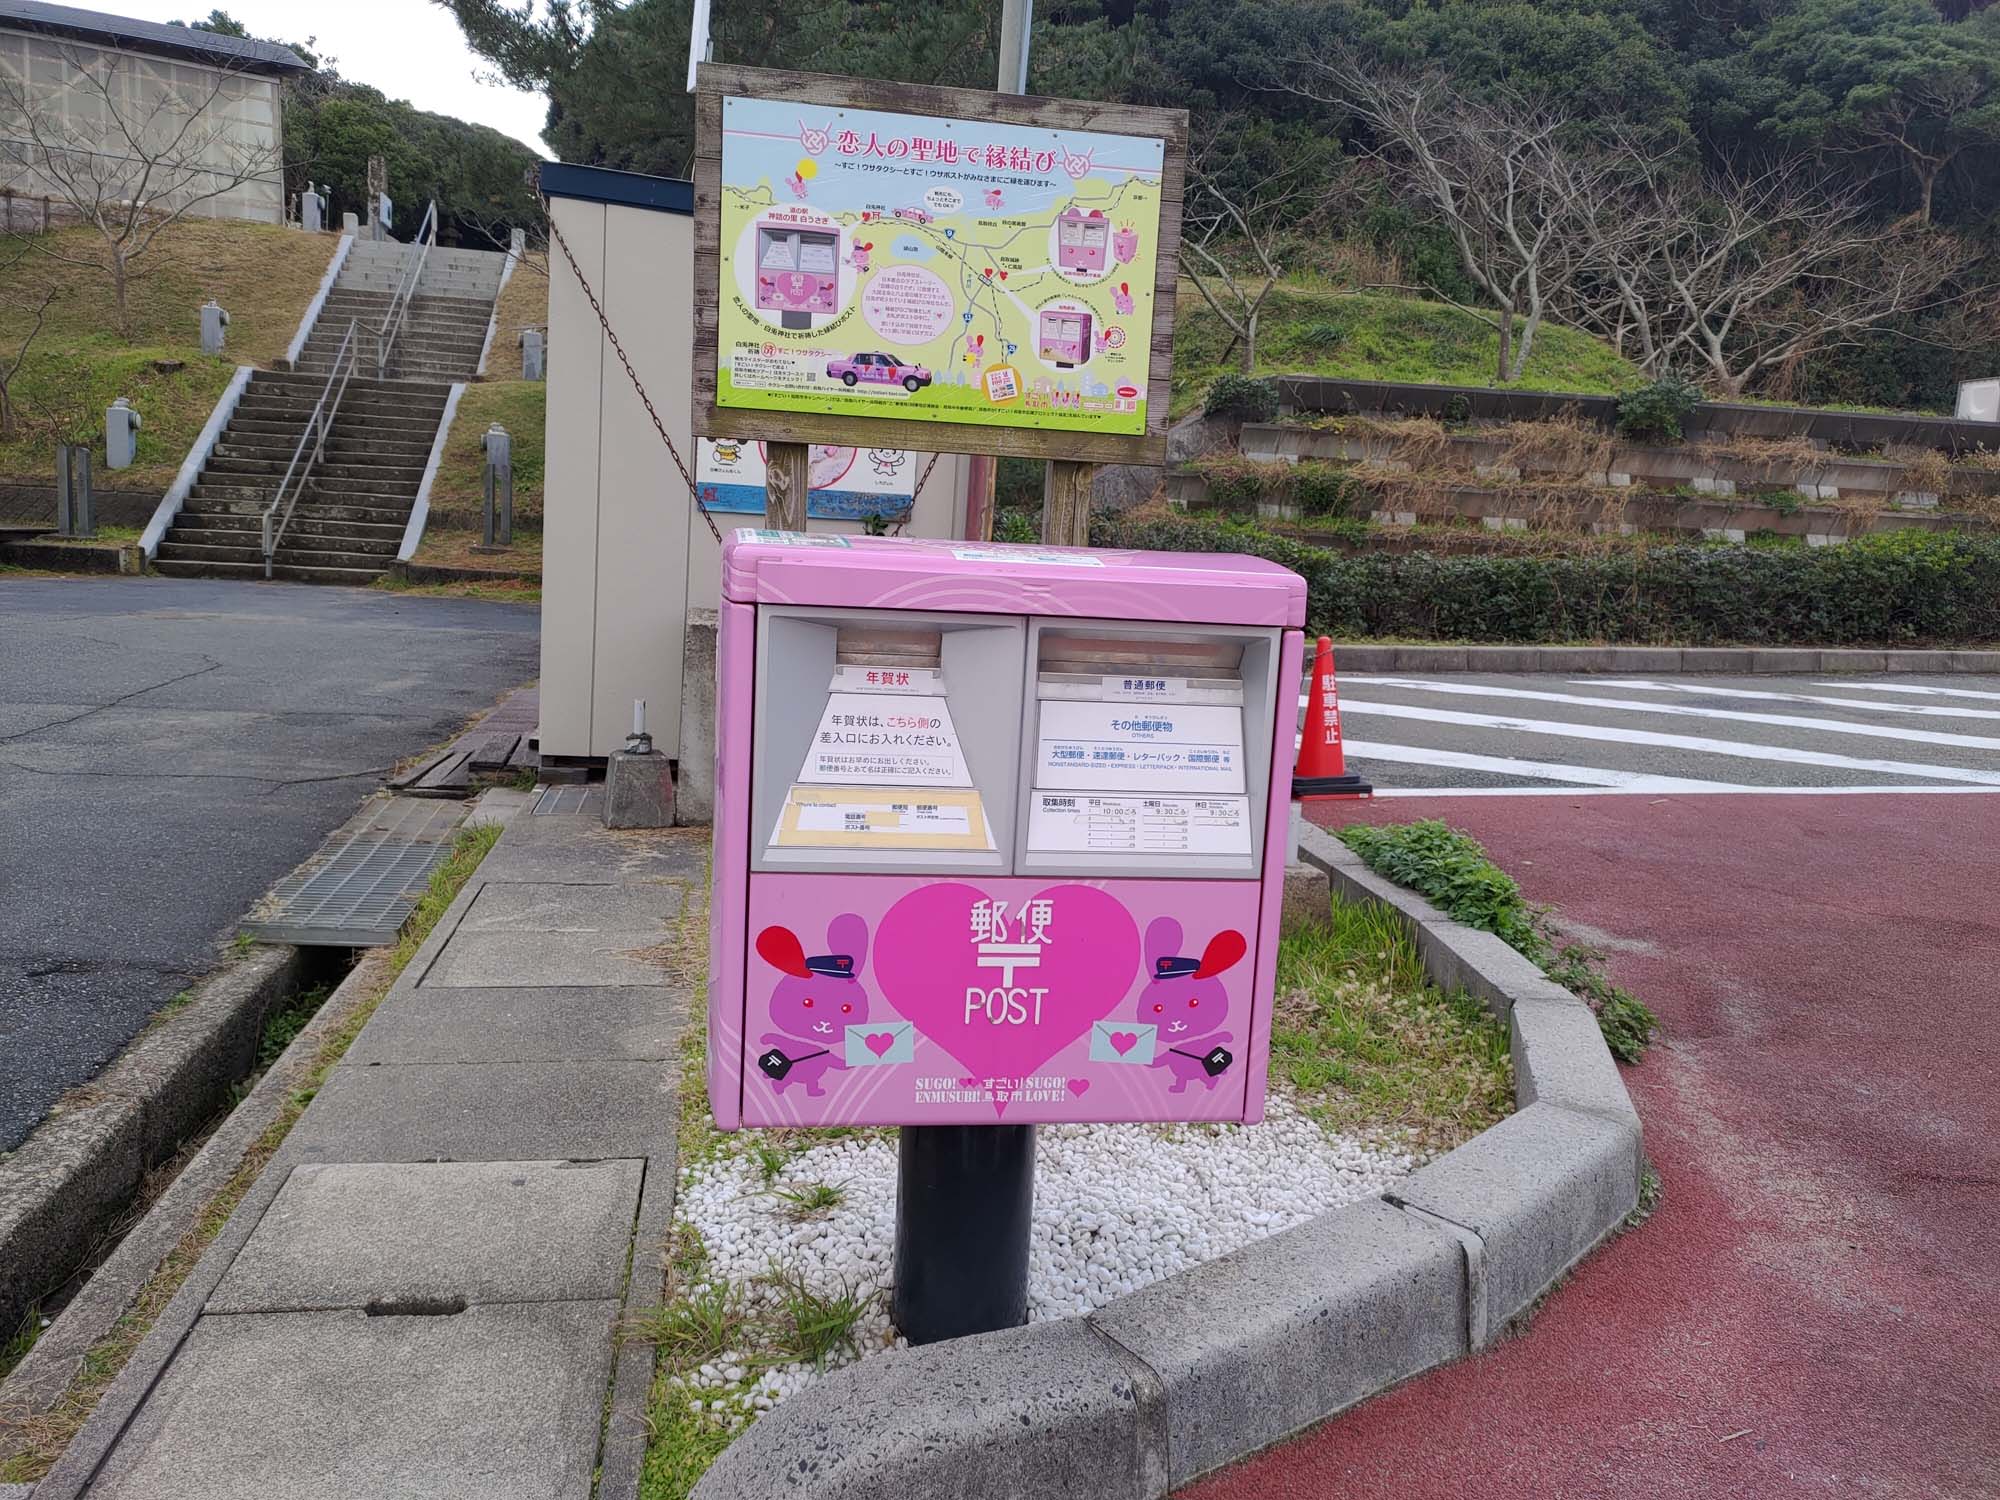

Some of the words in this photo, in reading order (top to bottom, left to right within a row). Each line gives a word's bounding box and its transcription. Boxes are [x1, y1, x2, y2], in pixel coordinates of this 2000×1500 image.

[837, 131, 1056, 172] 恋人の聖地で縁結び
[790, 207, 809, 215] 道の駅
[768, 212, 798, 222] 神話の里
[800, 214, 829, 225] 白うさぎ
[866, 671, 909, 687] 年賀状
[1123, 679, 1167, 692] 普通郵便
[1321, 673, 1340, 745] 駐車禁止
[832, 714, 942, 730] 年賀状は、こちら側の
[1111, 720, 1174, 734] その他郵便物
[820, 732, 952, 749] 差入口にお入れください。
[1043, 798, 1076, 807] 取集時刻
[1144, 800, 1161, 808] 土曜日
[1195, 801, 1207, 809] 休日
[969, 898, 1055, 945] 郵便
[964, 987, 1050, 1026] POST
[915, 1077, 957, 1090] SUGO!
[1025, 1076, 1066, 1089] SUGO!
[982, 1090, 1024, 1102] 鳥取市
[1025, 1089, 1066, 1103] LOVE!
